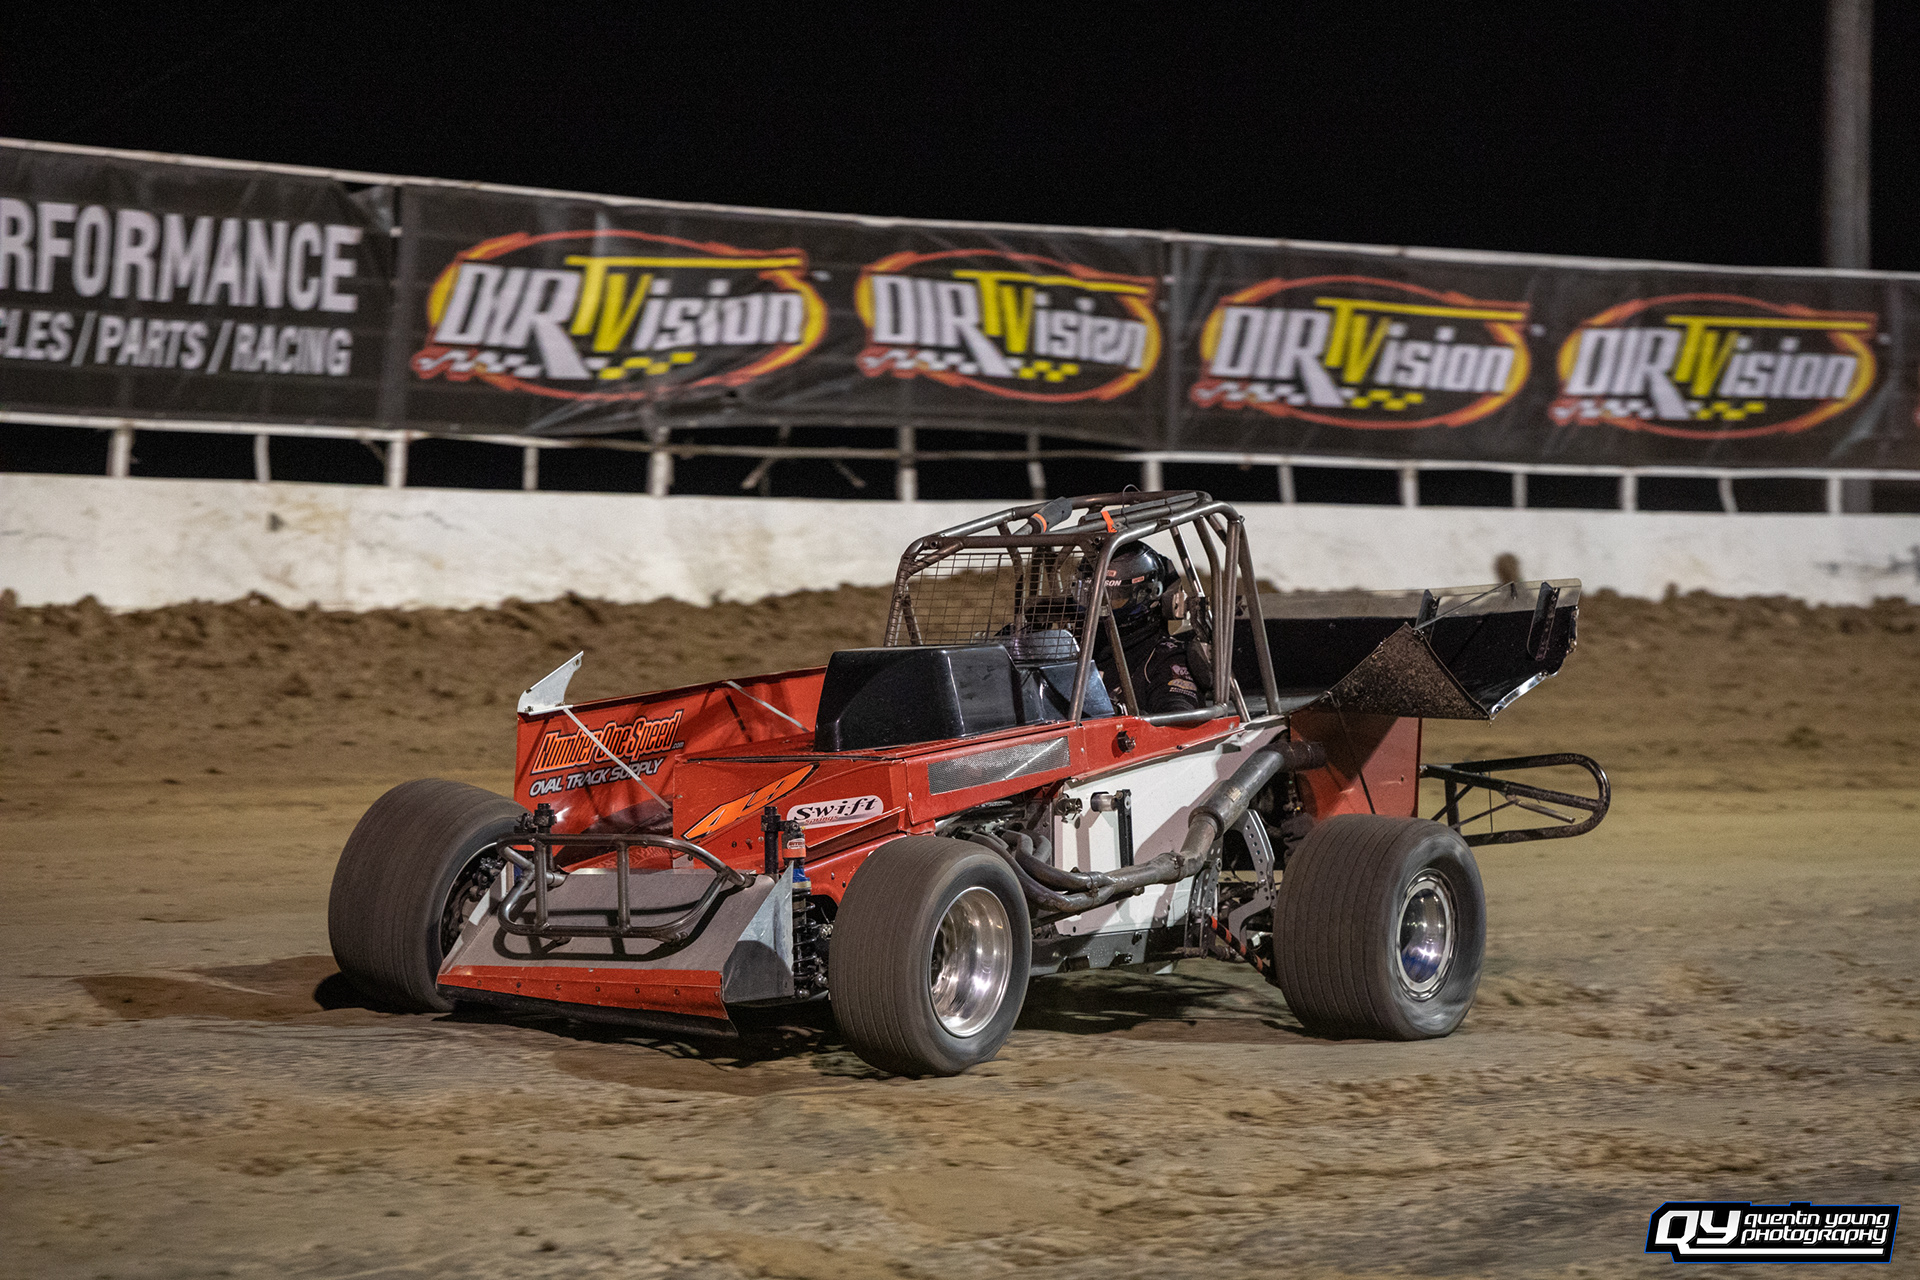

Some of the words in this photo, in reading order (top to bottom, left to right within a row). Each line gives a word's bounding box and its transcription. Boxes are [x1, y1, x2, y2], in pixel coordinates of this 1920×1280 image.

[0, 198, 364, 313] RFORMANCE
[1210, 297, 1524, 408] DIRTVision
[1566, 315, 1870, 421] DIRTVision
[530, 776, 563, 796] OVAL
[567, 767, 611, 789] TRACK
[609, 758, 664, 781] SUPPLY
